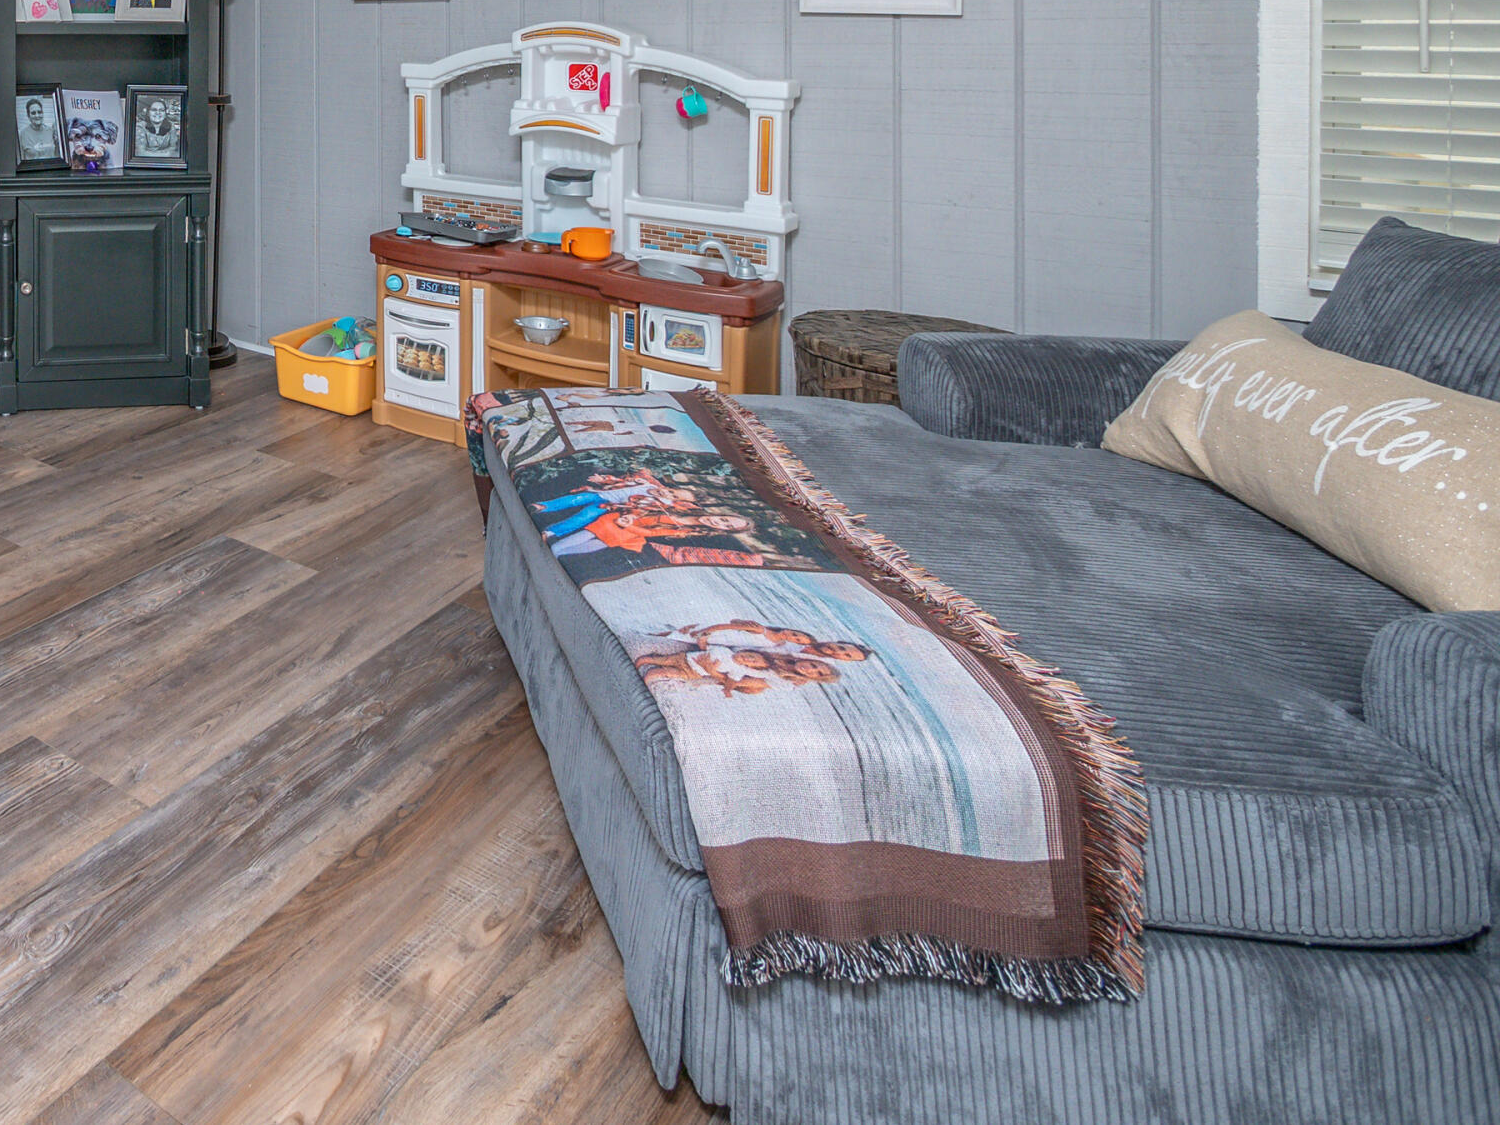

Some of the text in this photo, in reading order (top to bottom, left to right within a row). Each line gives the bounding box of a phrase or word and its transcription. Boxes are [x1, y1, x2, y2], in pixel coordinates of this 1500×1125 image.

[570, 65, 595, 89] STEP
[70, 96, 101, 110] HERSHEY
[1234, 370, 1317, 424] ever
